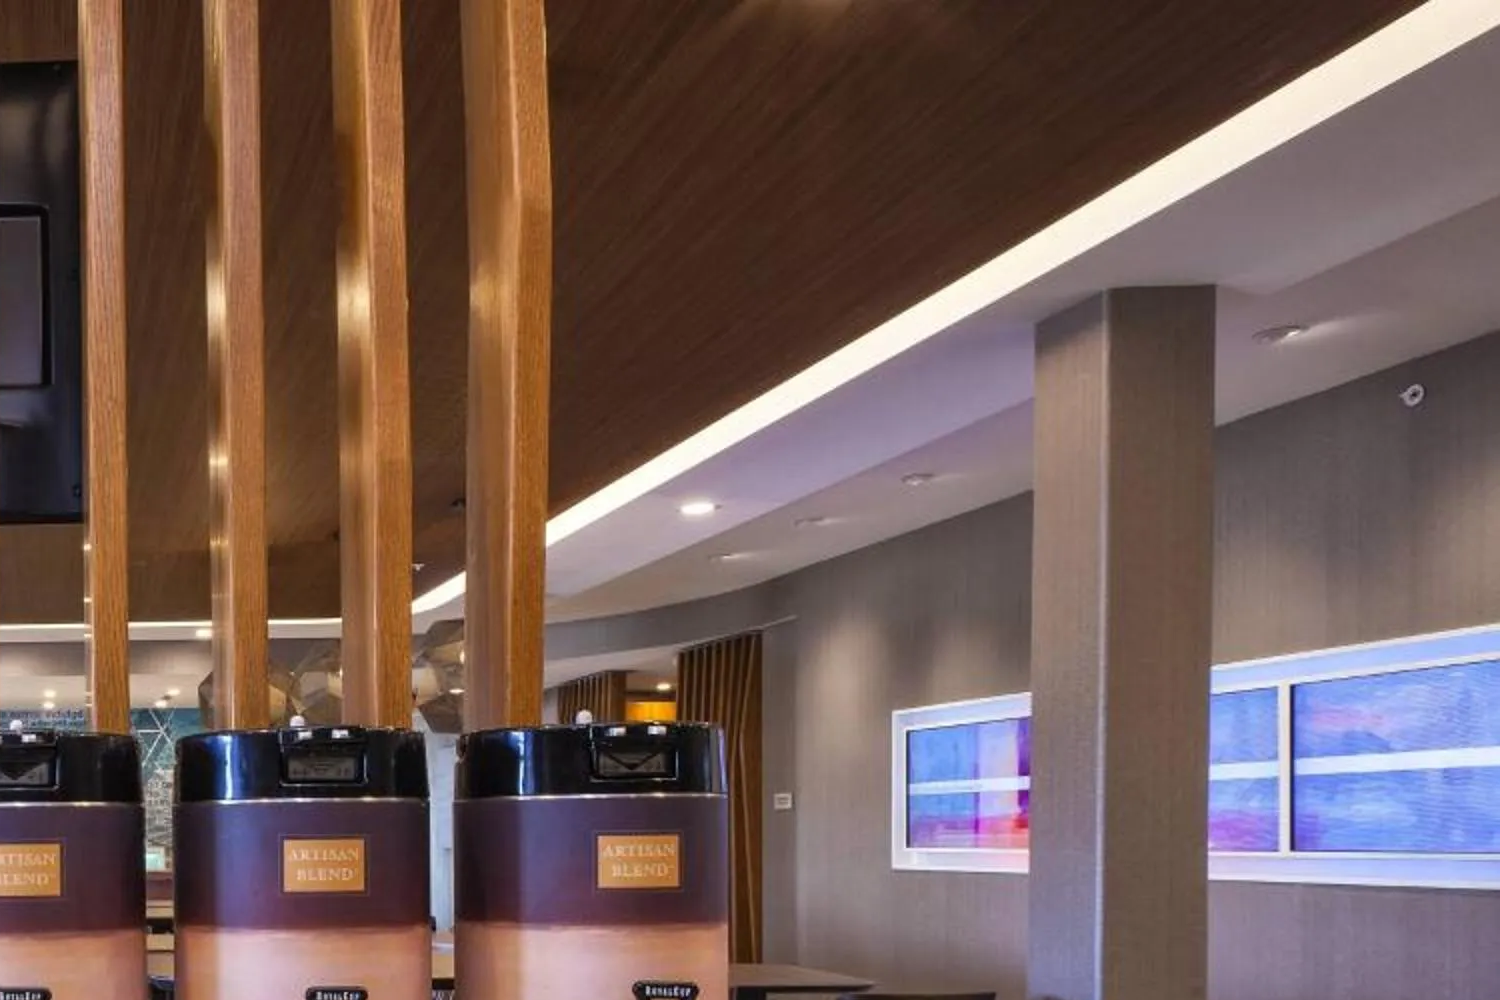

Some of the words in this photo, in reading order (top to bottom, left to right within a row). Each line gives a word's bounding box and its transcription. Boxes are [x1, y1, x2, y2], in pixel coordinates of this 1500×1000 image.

[289, 848, 359, 861] ARTISAN
[603, 844, 675, 857] ARTISAN
[296, 868, 353, 881] BLEND
[611, 863, 669, 877] BLEND
